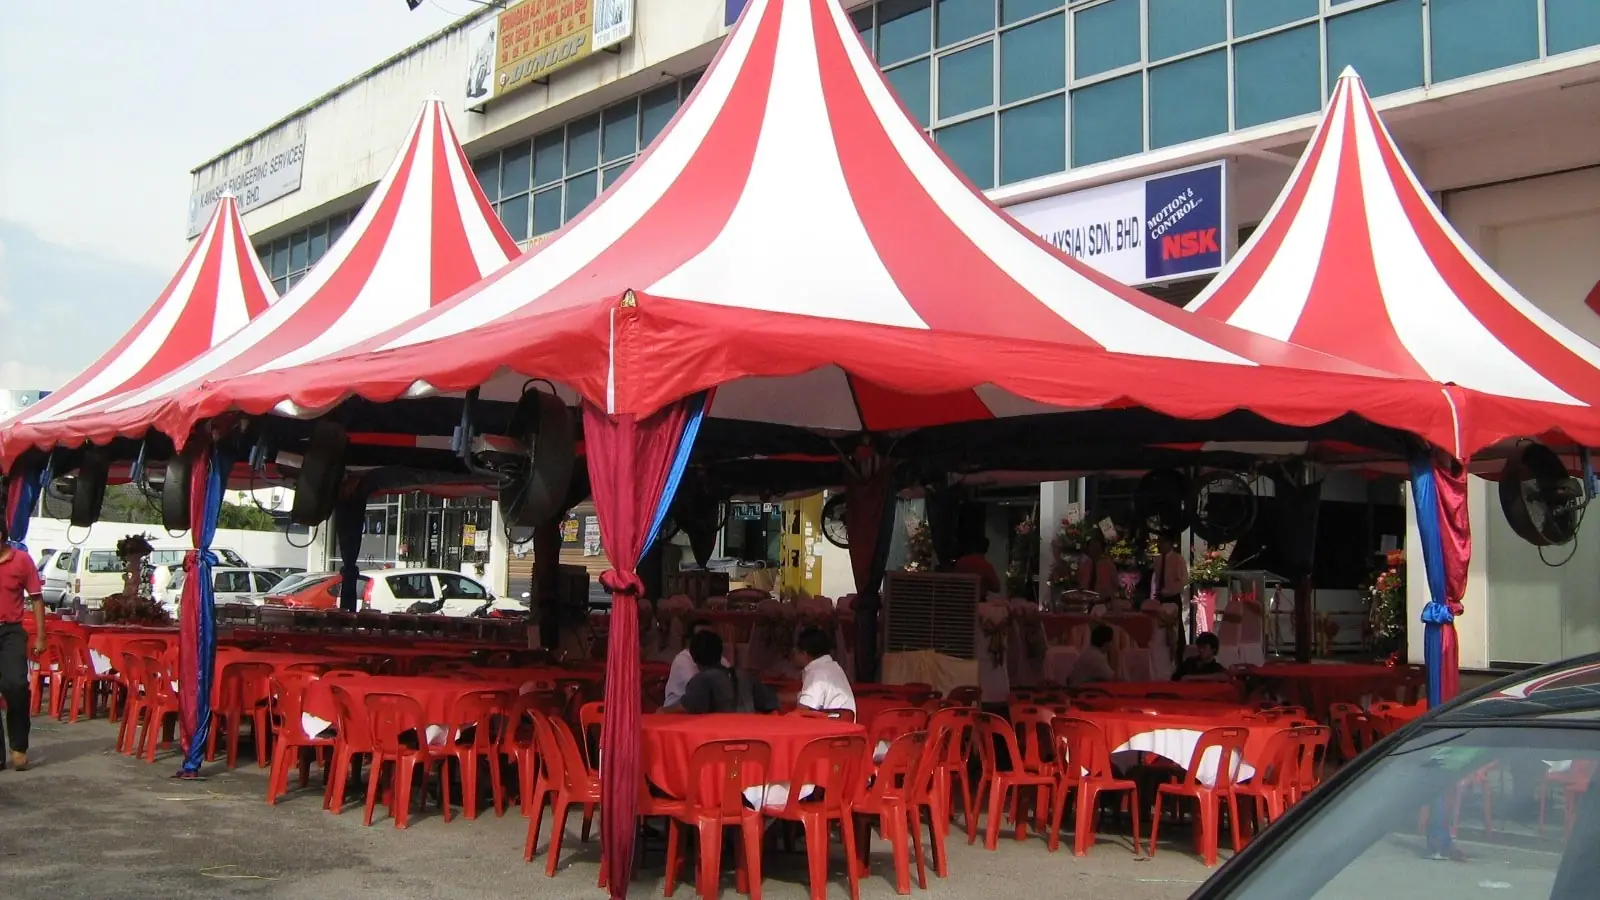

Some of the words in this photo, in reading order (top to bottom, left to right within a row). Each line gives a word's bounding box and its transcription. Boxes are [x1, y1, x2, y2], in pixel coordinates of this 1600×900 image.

[510, 35, 586, 84] DUNLOP
[229, 162, 268, 193] ENGINEERING
[270, 144, 304, 174] SERVICES
[1147, 192, 1187, 230] MOTION
[1186, 187, 1194, 197] &
[1088, 221, 1114, 256] SDN.
[1116, 216, 1142, 251] BHD.
[1163, 228, 1219, 260] NSK
